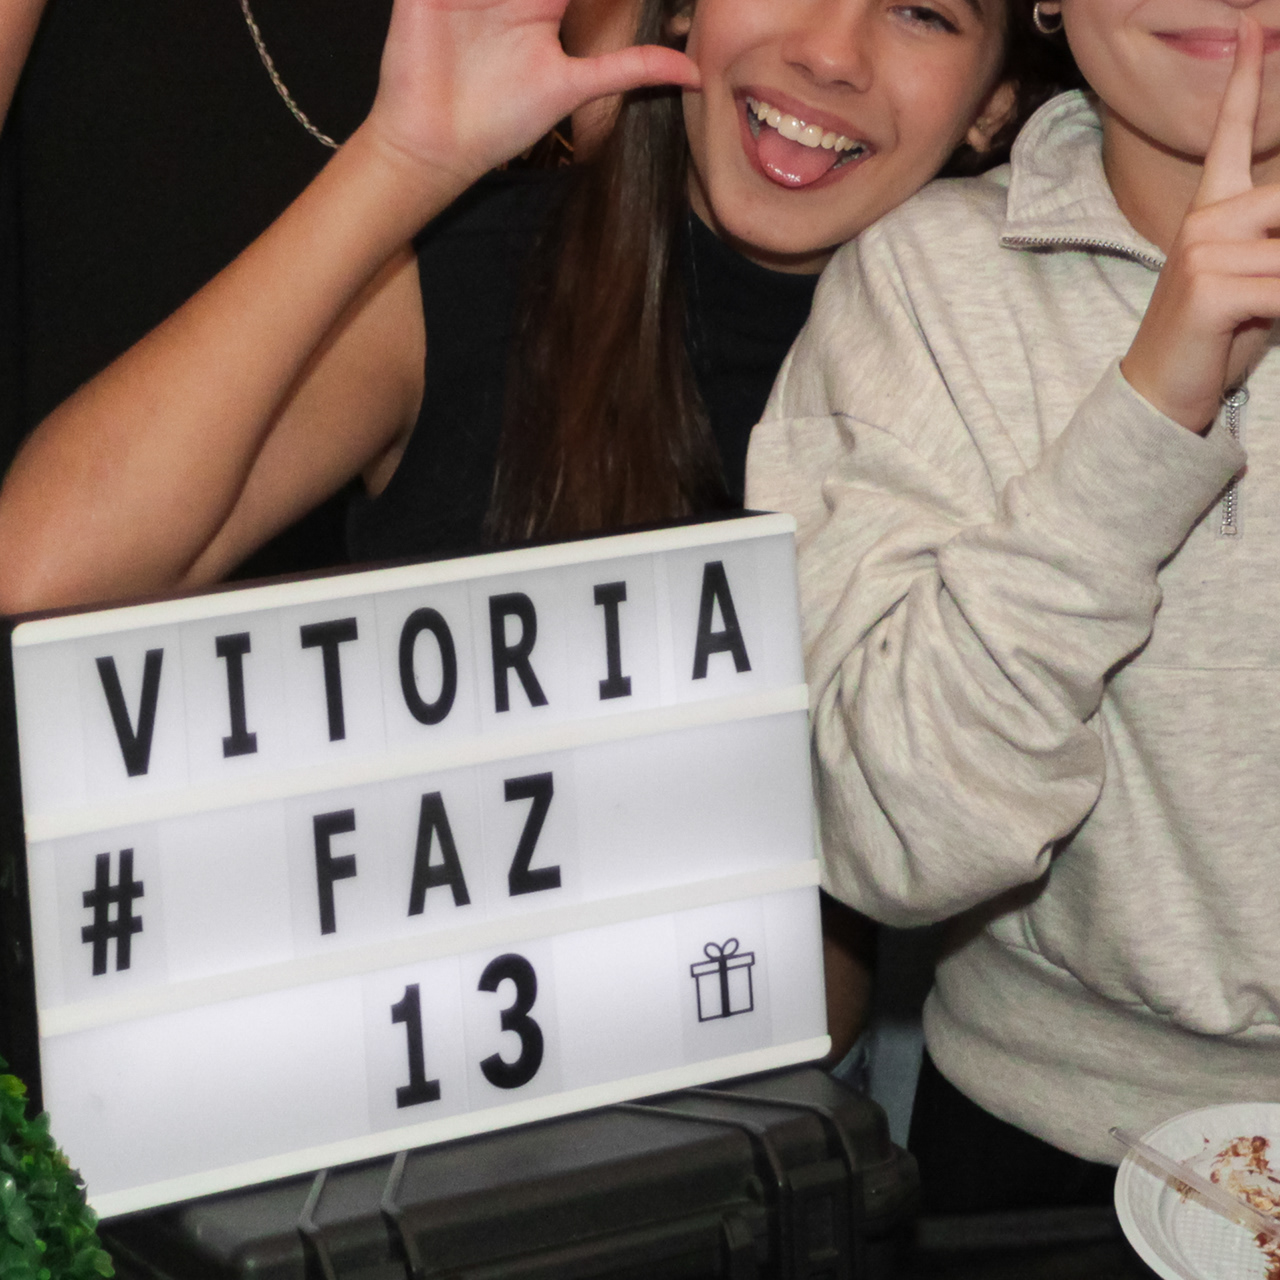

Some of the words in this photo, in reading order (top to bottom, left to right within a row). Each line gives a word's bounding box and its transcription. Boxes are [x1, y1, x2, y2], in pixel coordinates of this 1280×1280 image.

[95, 560, 752, 778] VITORIA
[81, 848, 145, 976] #
[312, 771, 562, 936] FAZ
[390, 953, 546, 1110] 13
